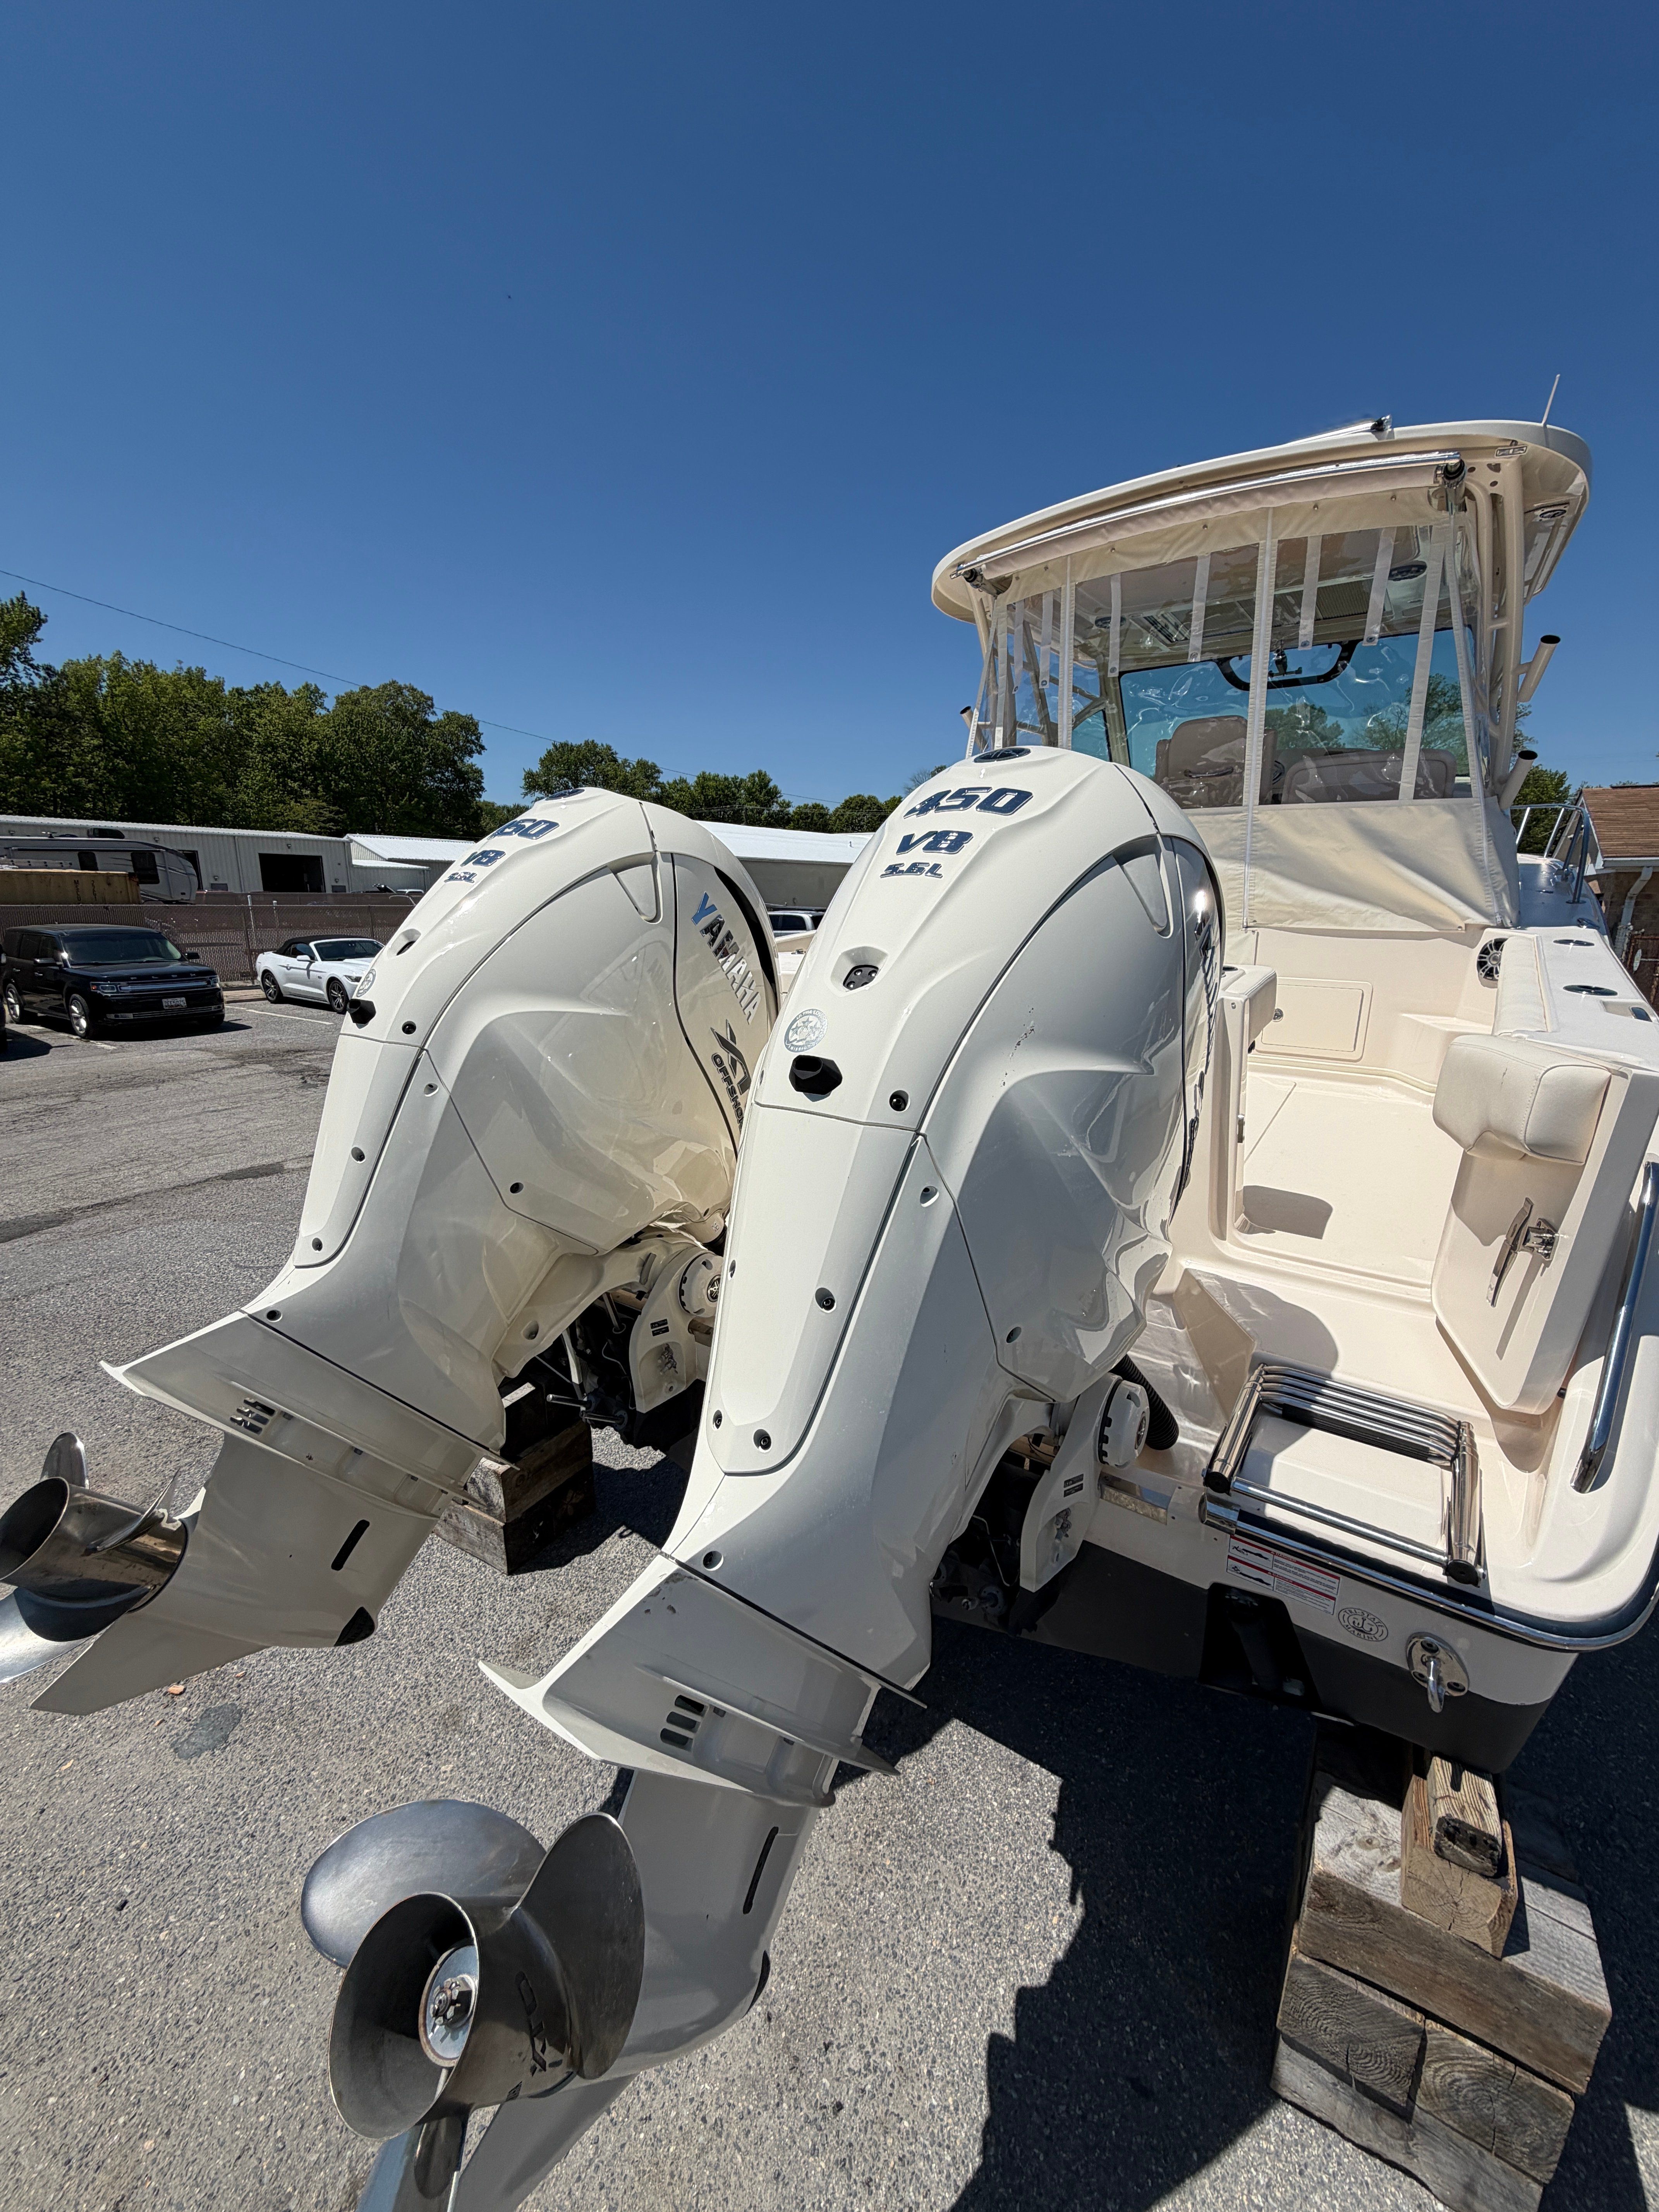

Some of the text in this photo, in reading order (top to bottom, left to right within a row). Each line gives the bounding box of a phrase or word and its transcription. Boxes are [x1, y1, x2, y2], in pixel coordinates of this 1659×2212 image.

[903, 787, 1034, 819] 450
[896, 830, 974, 855] V8
[460, 850, 506, 867] V8
[691, 891, 761, 1025] YAMAHA
[711, 1053, 744, 1135] OFFSHOR
[1344, 1609, 1384, 1628] TRI-STATE
[1344, 1624, 1378, 1640] MARINE
